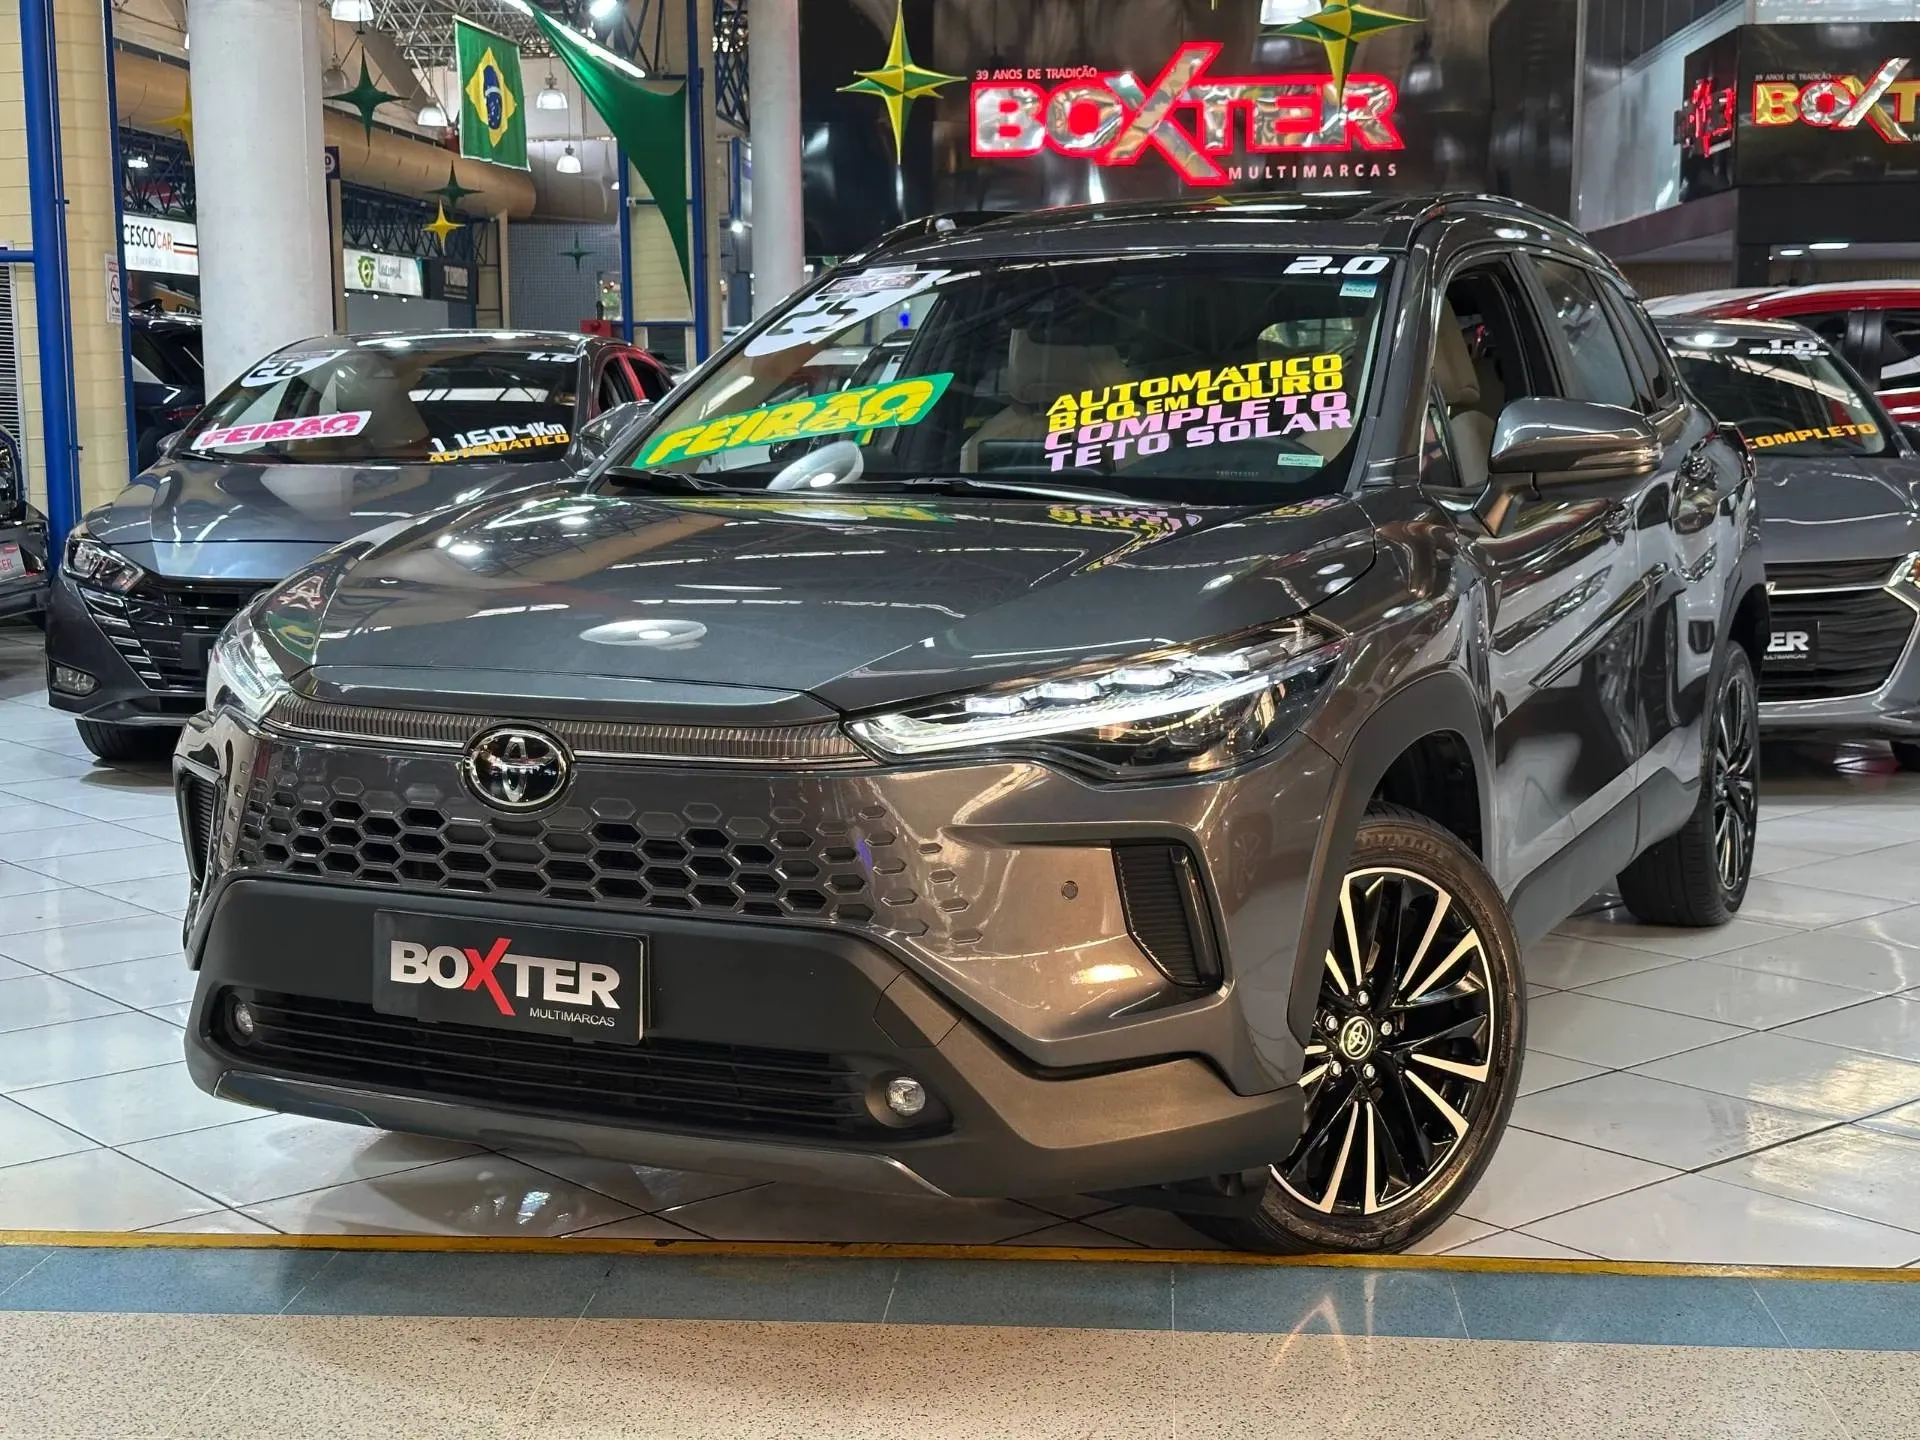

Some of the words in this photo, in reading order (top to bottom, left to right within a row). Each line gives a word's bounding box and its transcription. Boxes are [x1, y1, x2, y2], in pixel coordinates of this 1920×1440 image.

[975, 70, 988, 80] 39
[993, 68, 1022, 80] ANOS
[1027, 69, 1041, 79] DE
[1045, 65, 1097, 79] TRADIÇÃO
[971, 41, 1405, 186] BOXTER
[1228, 163, 1398, 181] MULTIMARCAS
[1282, 255, 1391, 275] 2.0
[1768, 340, 1818, 351] 1.0
[249, 360, 304, 378] 26
[1146, 395, 1188, 415] EM
[1197, 371, 1343, 406] COURO
[646, 380, 933, 464] FEIRÃO
[1044, 391, 1348, 451] COMPLETO
[1044, 432, 1170, 473] TETO
[1186, 408, 1354, 448] SOLAR
[390, 937, 621, 1017] BOXTER
[529, 1007, 616, 1028] MULTIMARCAS
